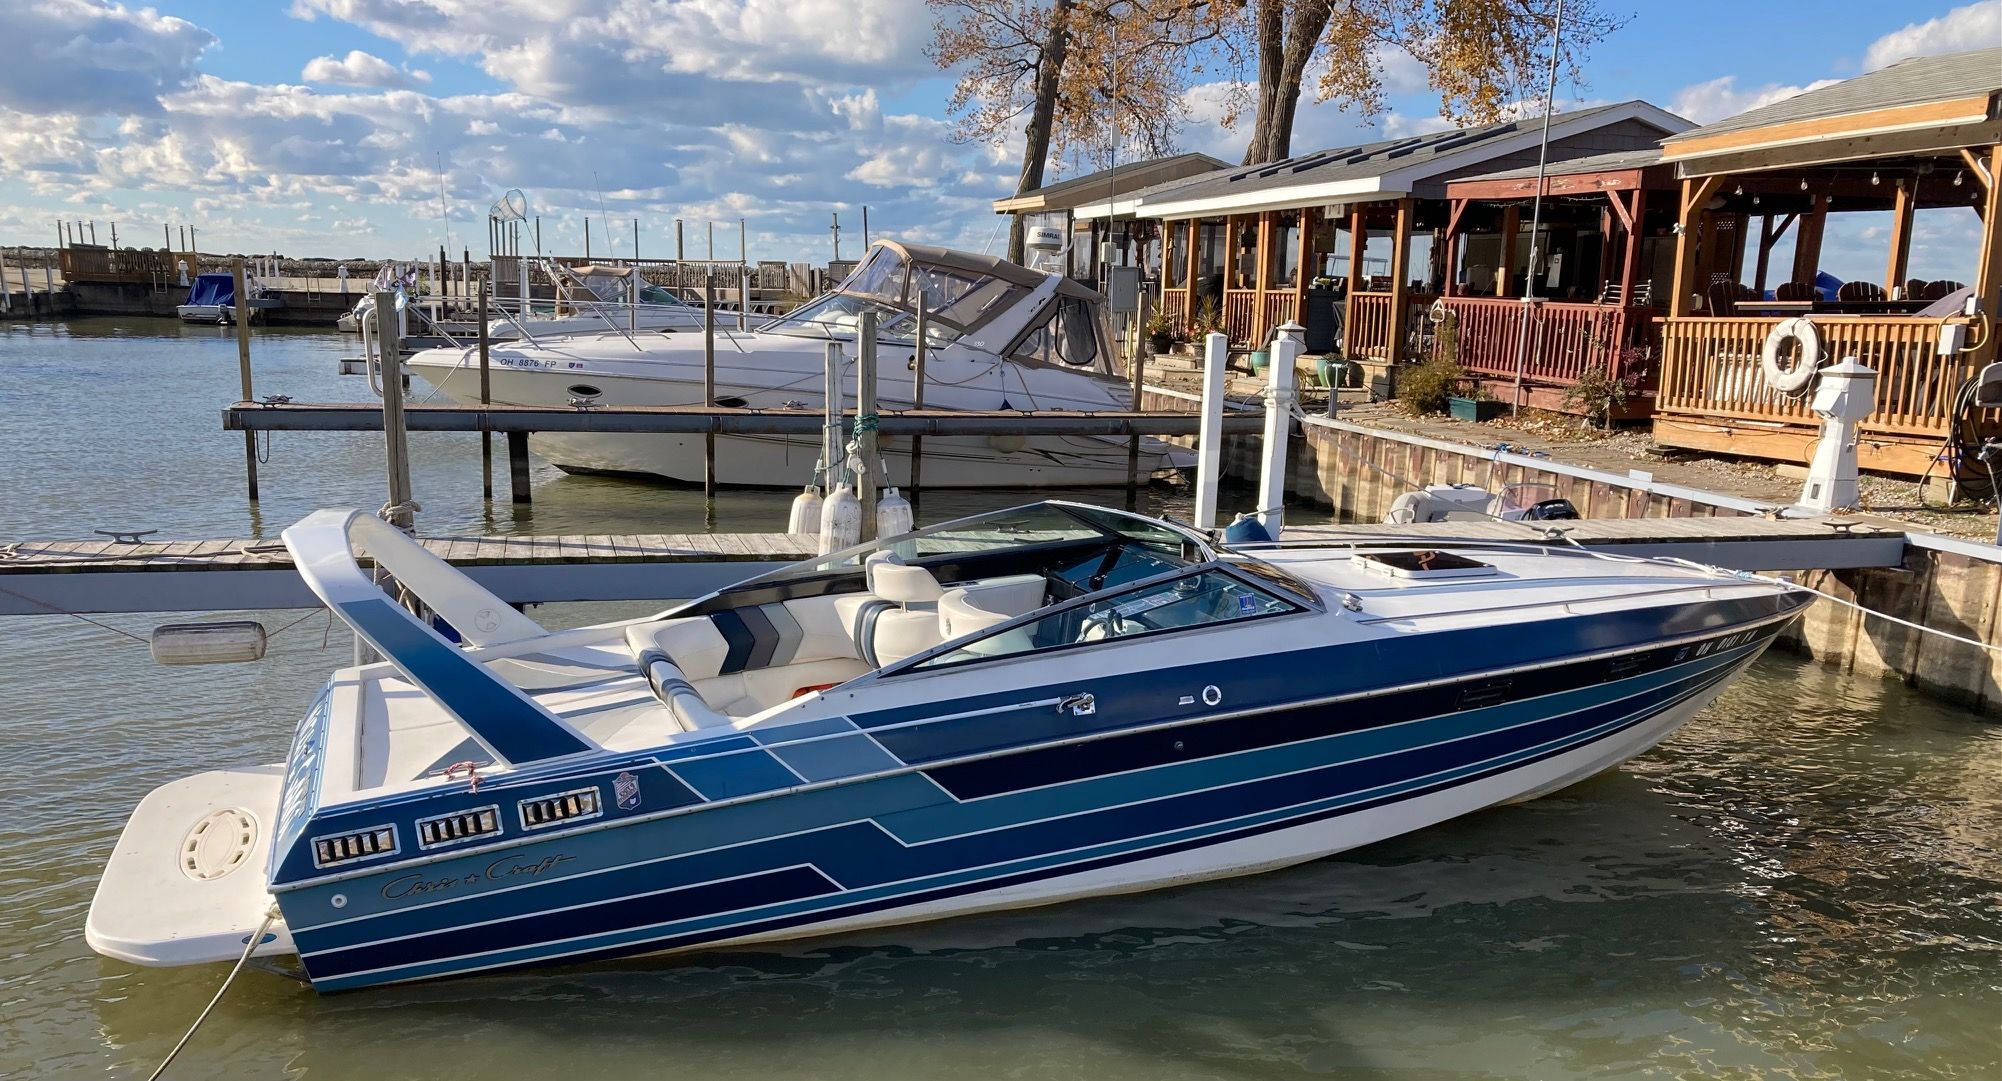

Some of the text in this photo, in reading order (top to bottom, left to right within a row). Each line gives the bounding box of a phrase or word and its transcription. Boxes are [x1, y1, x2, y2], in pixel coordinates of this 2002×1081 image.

[500, 358, 557, 368] OH 8876 FP
